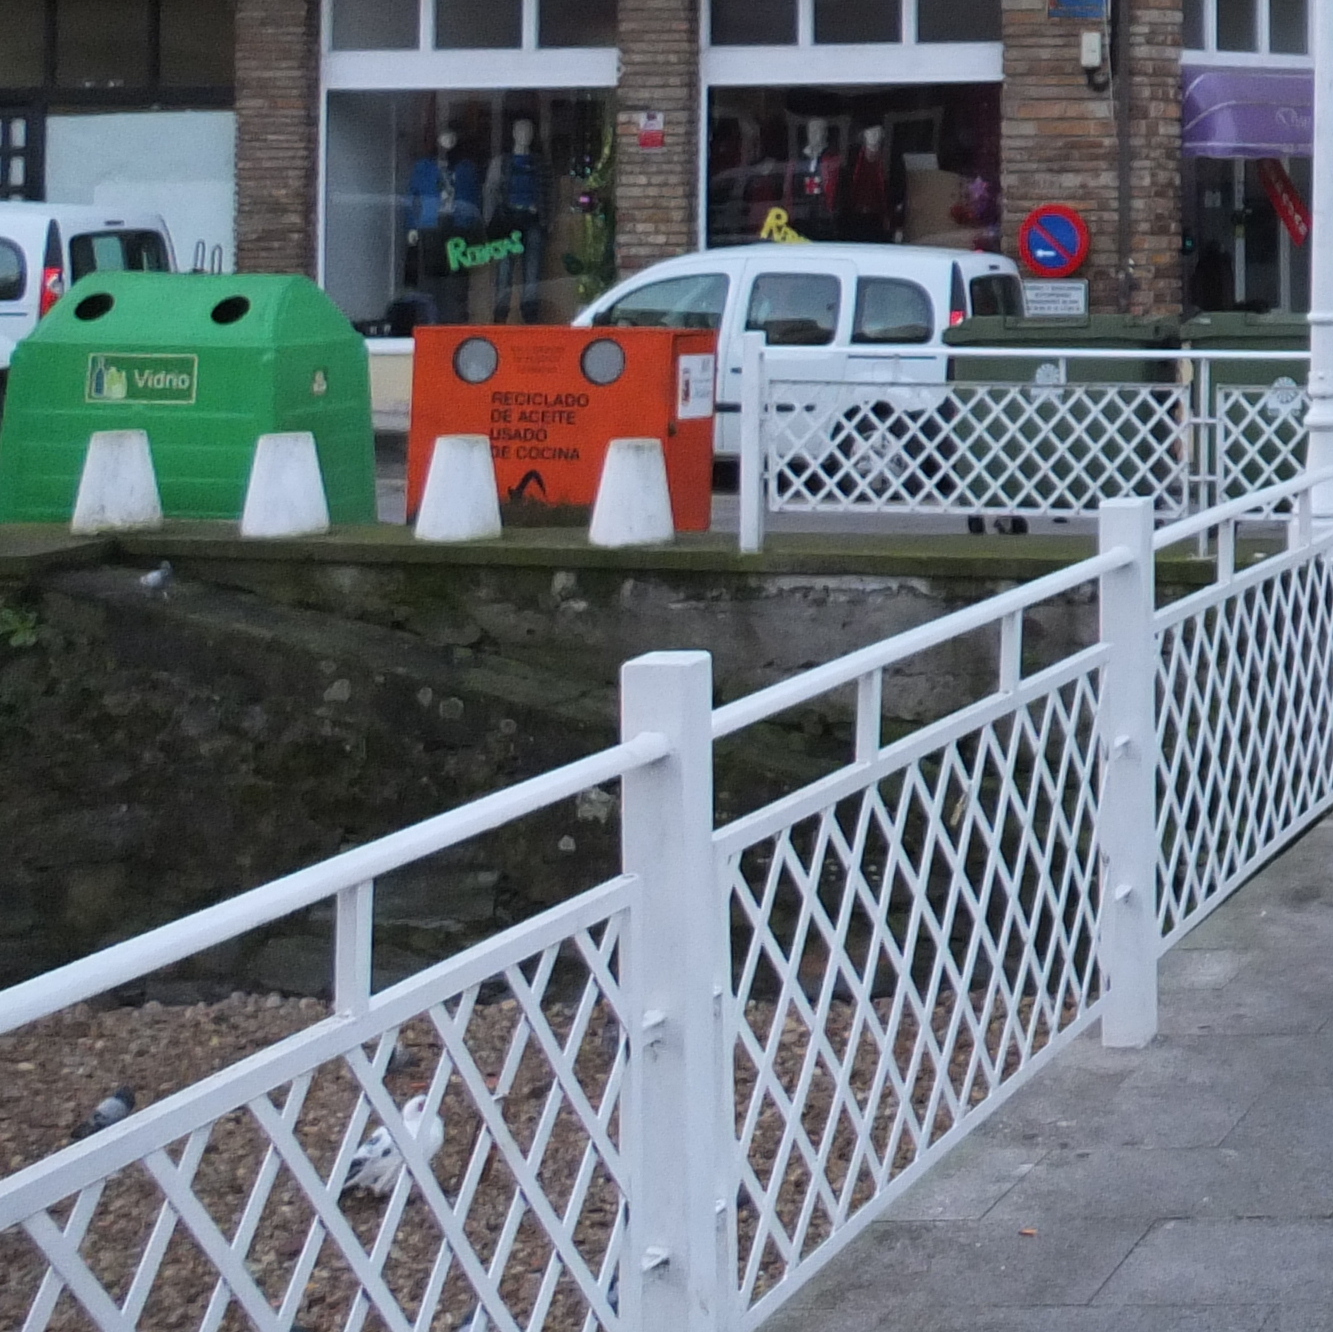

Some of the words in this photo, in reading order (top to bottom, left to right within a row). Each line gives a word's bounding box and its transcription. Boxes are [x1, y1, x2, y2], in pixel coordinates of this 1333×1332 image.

[134, 368, 190, 390] Vidrio
[491, 391, 589, 408] RECICLADO
[491, 408, 512, 423] DE
[518, 409, 576, 425] ACEITE
[490, 427, 548, 442] USADO
[492, 445, 511, 459] DE
[516, 446, 580, 461] COCINA
